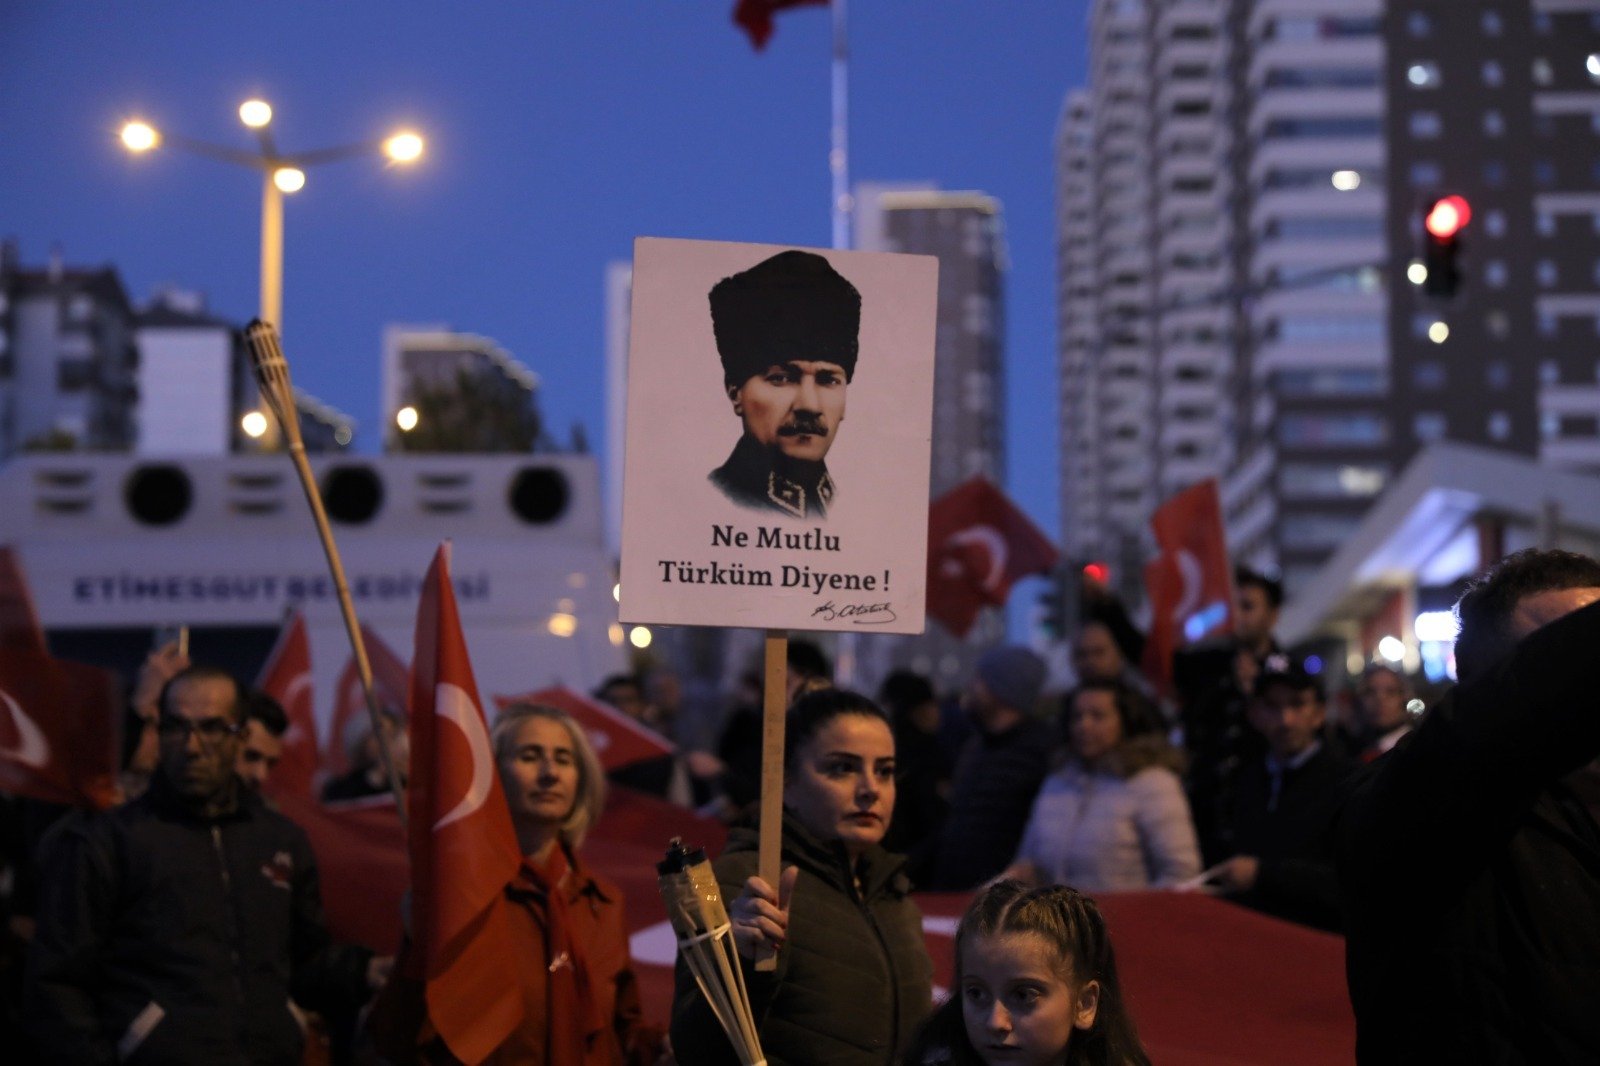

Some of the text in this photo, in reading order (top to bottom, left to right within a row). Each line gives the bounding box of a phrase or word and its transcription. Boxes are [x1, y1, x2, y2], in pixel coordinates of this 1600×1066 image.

[711, 525, 841, 551] Ne Mutlu
[658, 561, 773, 586] Türküm
[781, 566, 876, 595] Diyene
